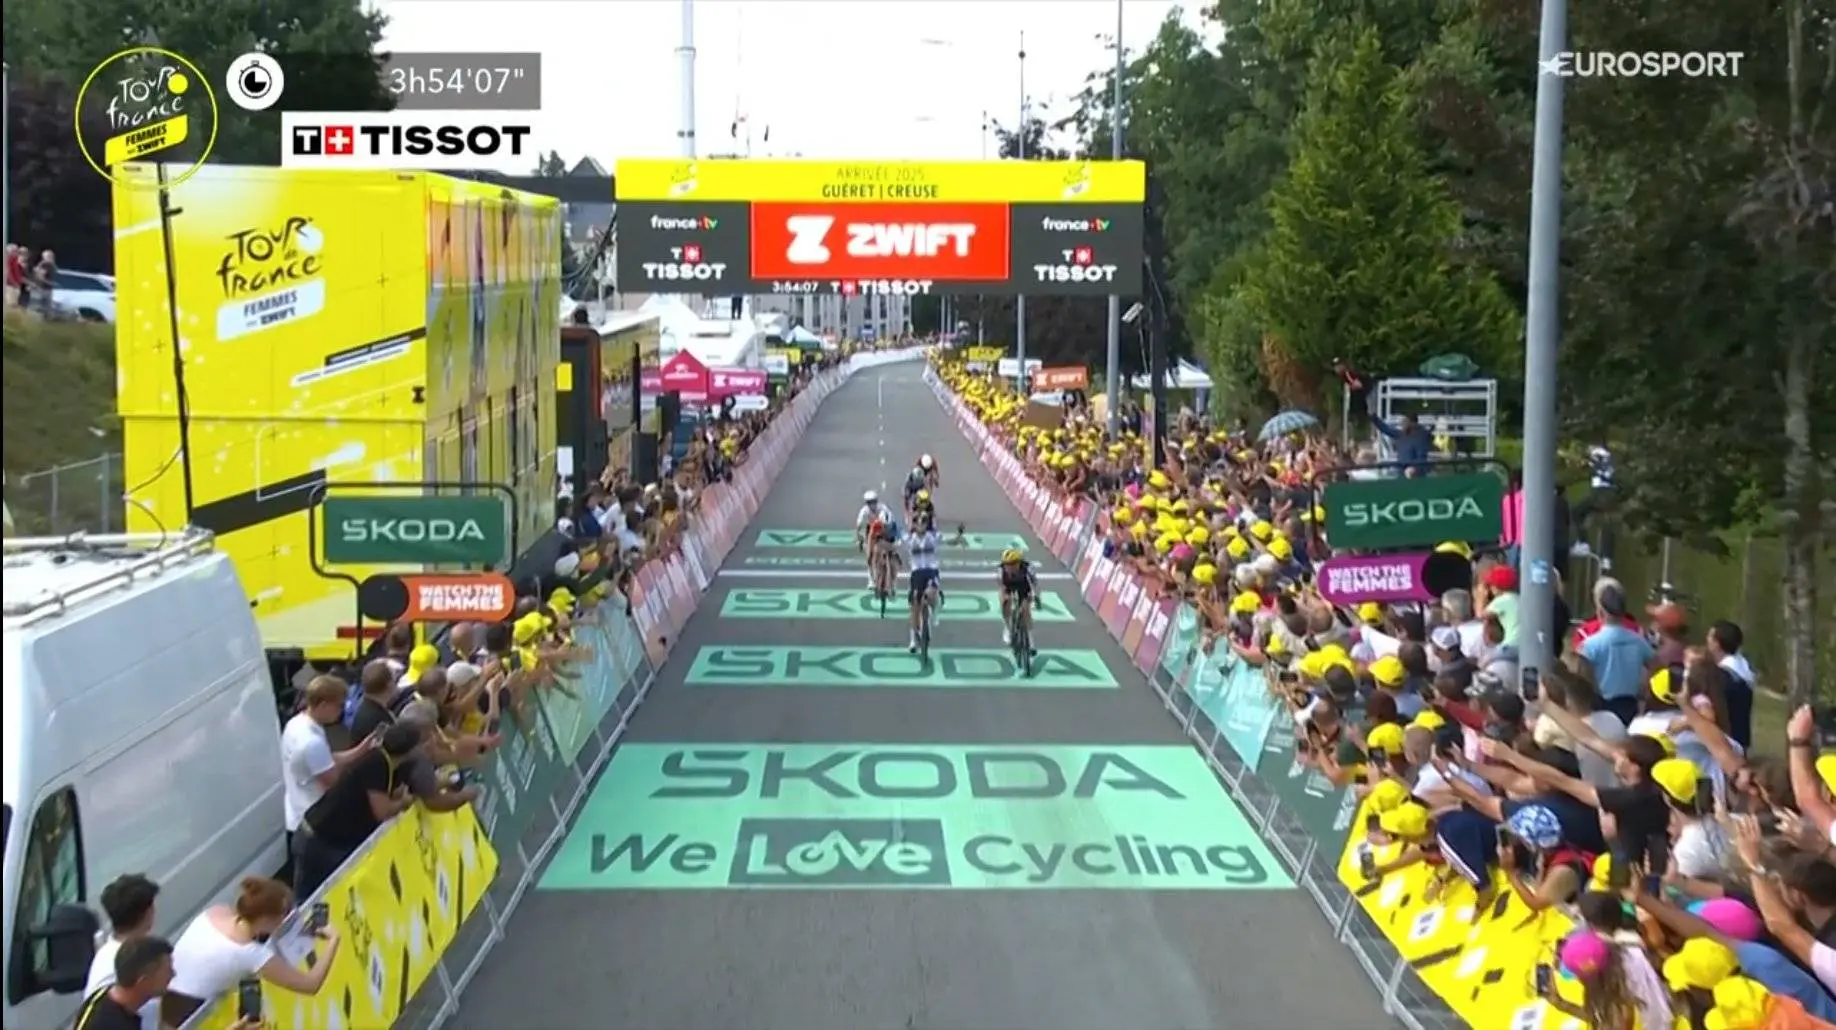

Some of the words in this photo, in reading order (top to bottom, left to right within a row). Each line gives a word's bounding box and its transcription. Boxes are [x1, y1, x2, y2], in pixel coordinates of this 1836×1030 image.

[821, 184, 875, 198] GUÉRET
[887, 184, 939, 198] CREUSE
[846, 222, 977, 258] ZWIFT
[642, 263, 727, 280] TISSOT
[1033, 265, 1117, 282] TISSOT
[859, 280, 933, 295] TISSOT
[1327, 567, 1380, 581] WATCH
[1382, 563, 1411, 577] THE
[419, 584, 472, 599] WATCH
[475, 584, 503, 597] THE
[1328, 576, 1412, 595] FEMMES
[419, 597, 504, 613] FEMMES
[733, 591, 1065, 615] SKOD
[590, 832, 717, 875] We
[962, 833, 1268, 883] Cycling
